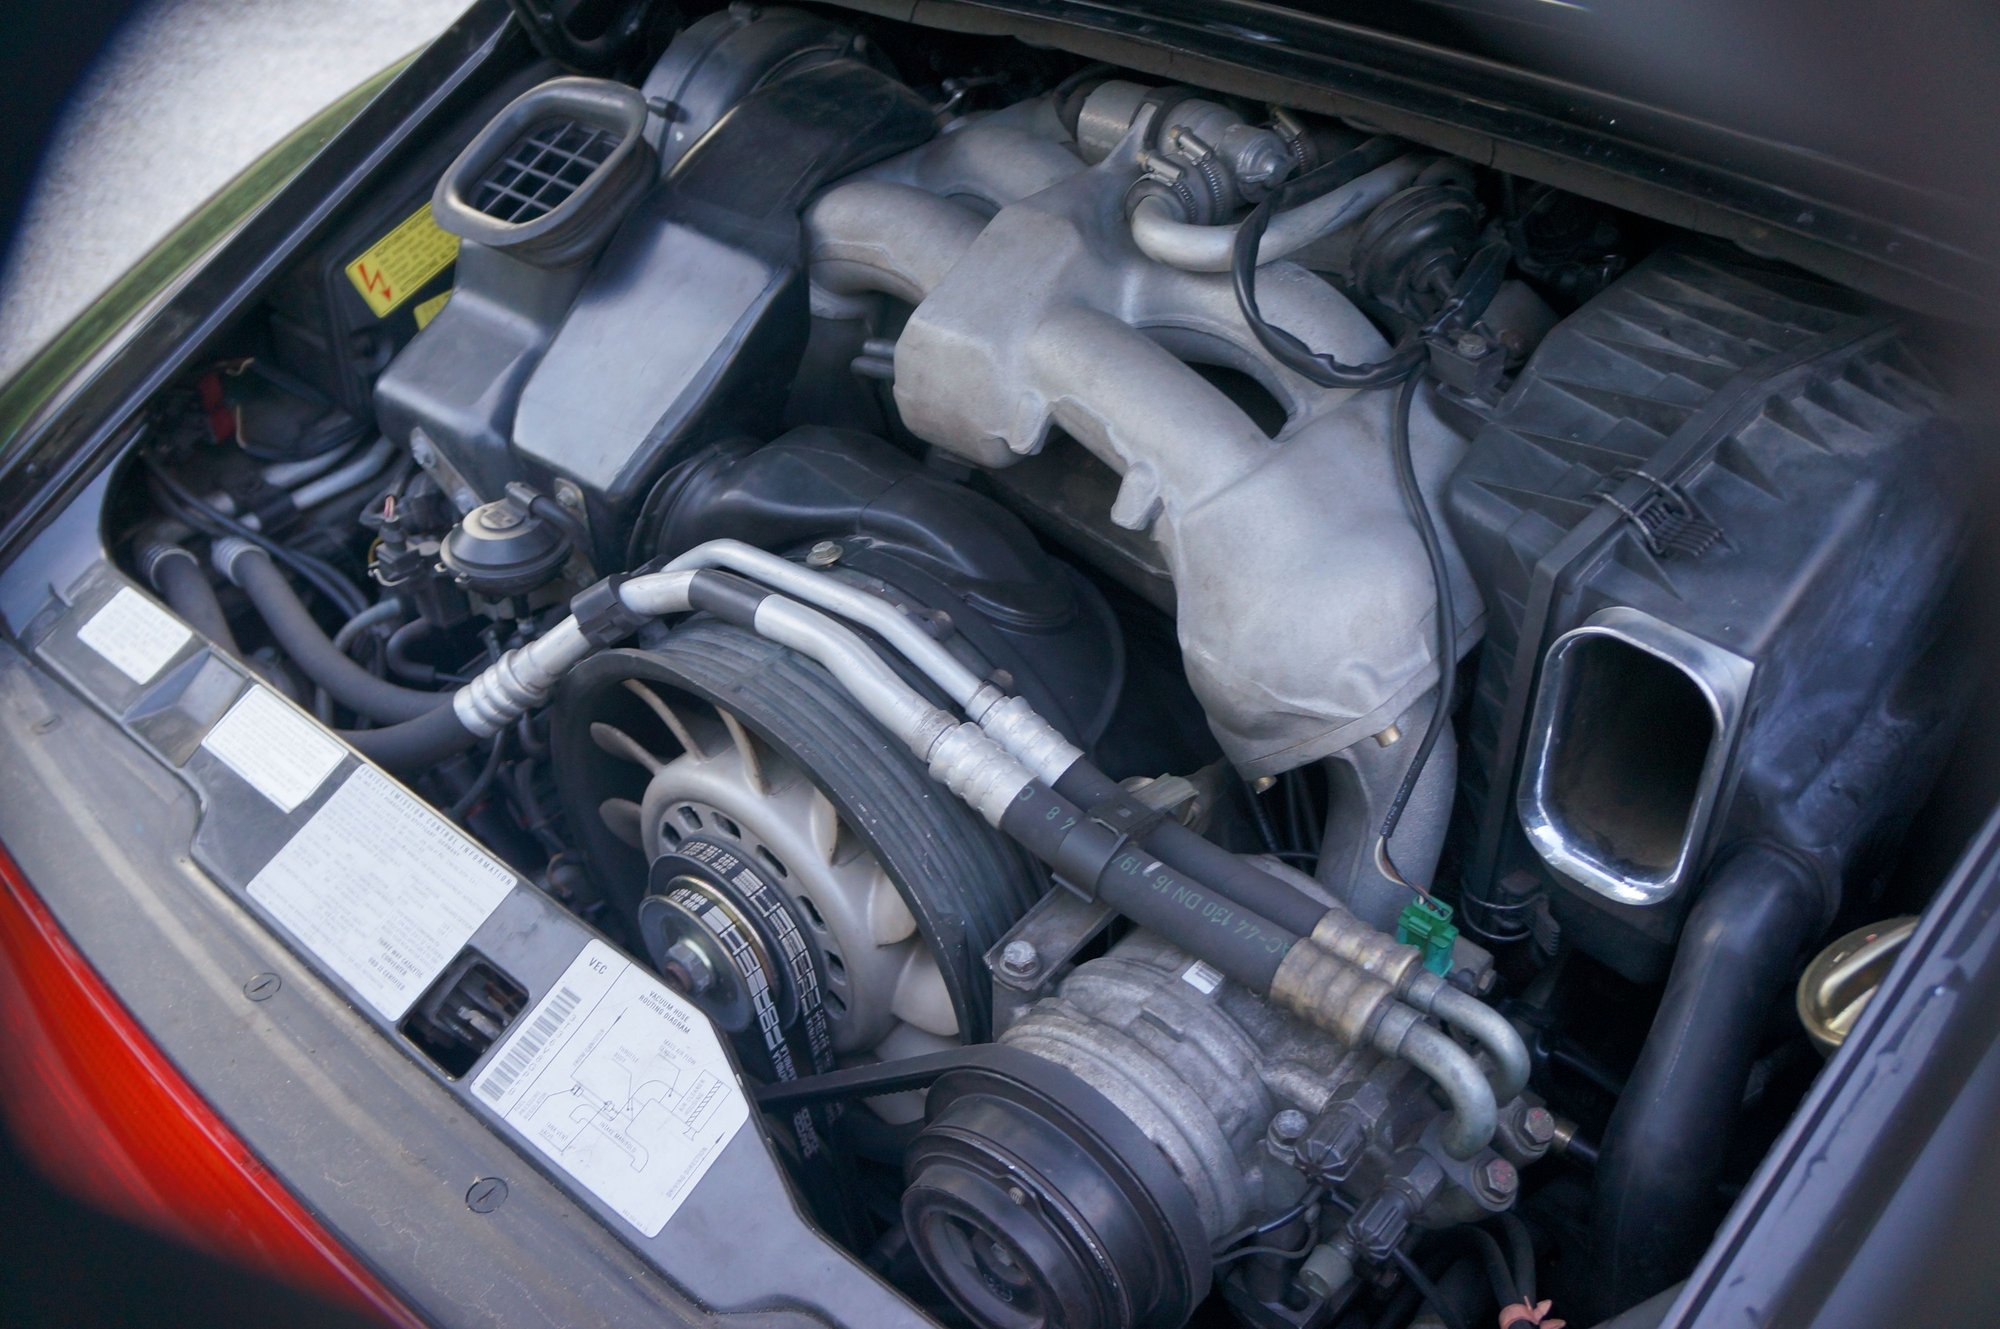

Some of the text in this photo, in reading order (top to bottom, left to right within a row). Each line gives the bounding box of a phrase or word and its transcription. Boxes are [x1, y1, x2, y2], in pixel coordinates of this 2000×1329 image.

[387, 789, 425, 820] EMISSION
[424, 817, 460, 846] CONTROL
[458, 842, 513, 887] INFORMATION
[1150, 872, 1174, 894] 16
[1170, 883, 1204, 911] DN
[587, 957, 608, 975] VEC
[637, 993, 691, 1035] ROUTING DIAGRAM
[647, 990, 690, 1023] VACUUM HOSE
